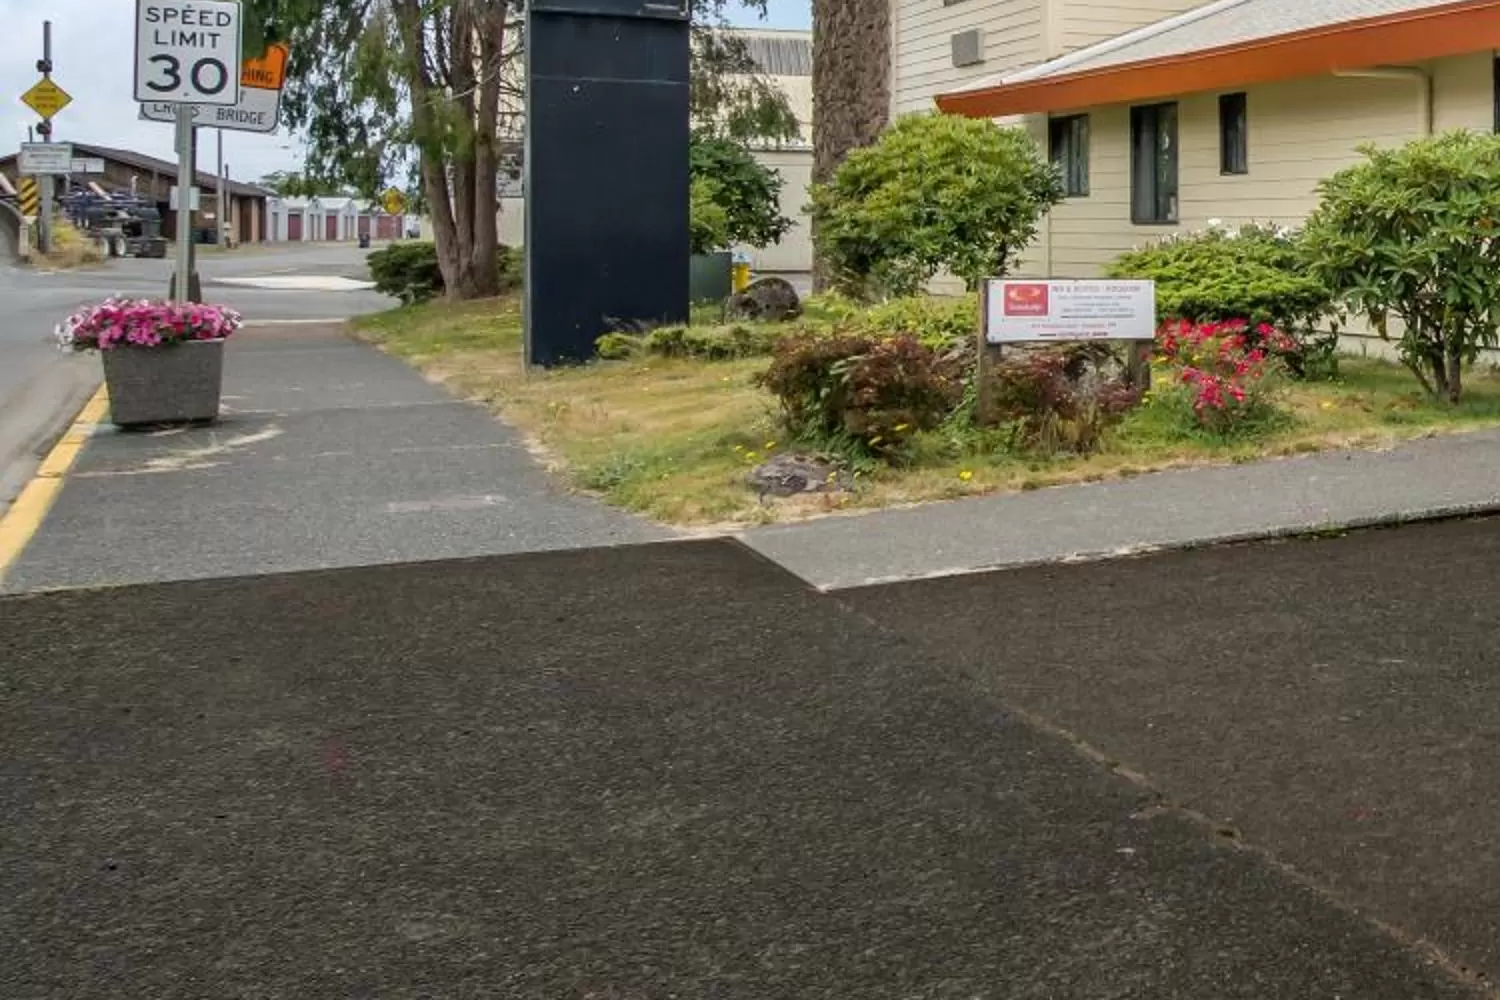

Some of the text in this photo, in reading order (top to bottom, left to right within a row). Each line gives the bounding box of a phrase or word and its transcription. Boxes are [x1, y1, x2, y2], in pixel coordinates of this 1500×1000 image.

[145, 6, 231, 27] SPEED
[154, 29, 221, 49] LIMIT
[145, 54, 229, 95] 30
[216, 107, 266, 125] BRIDGE
